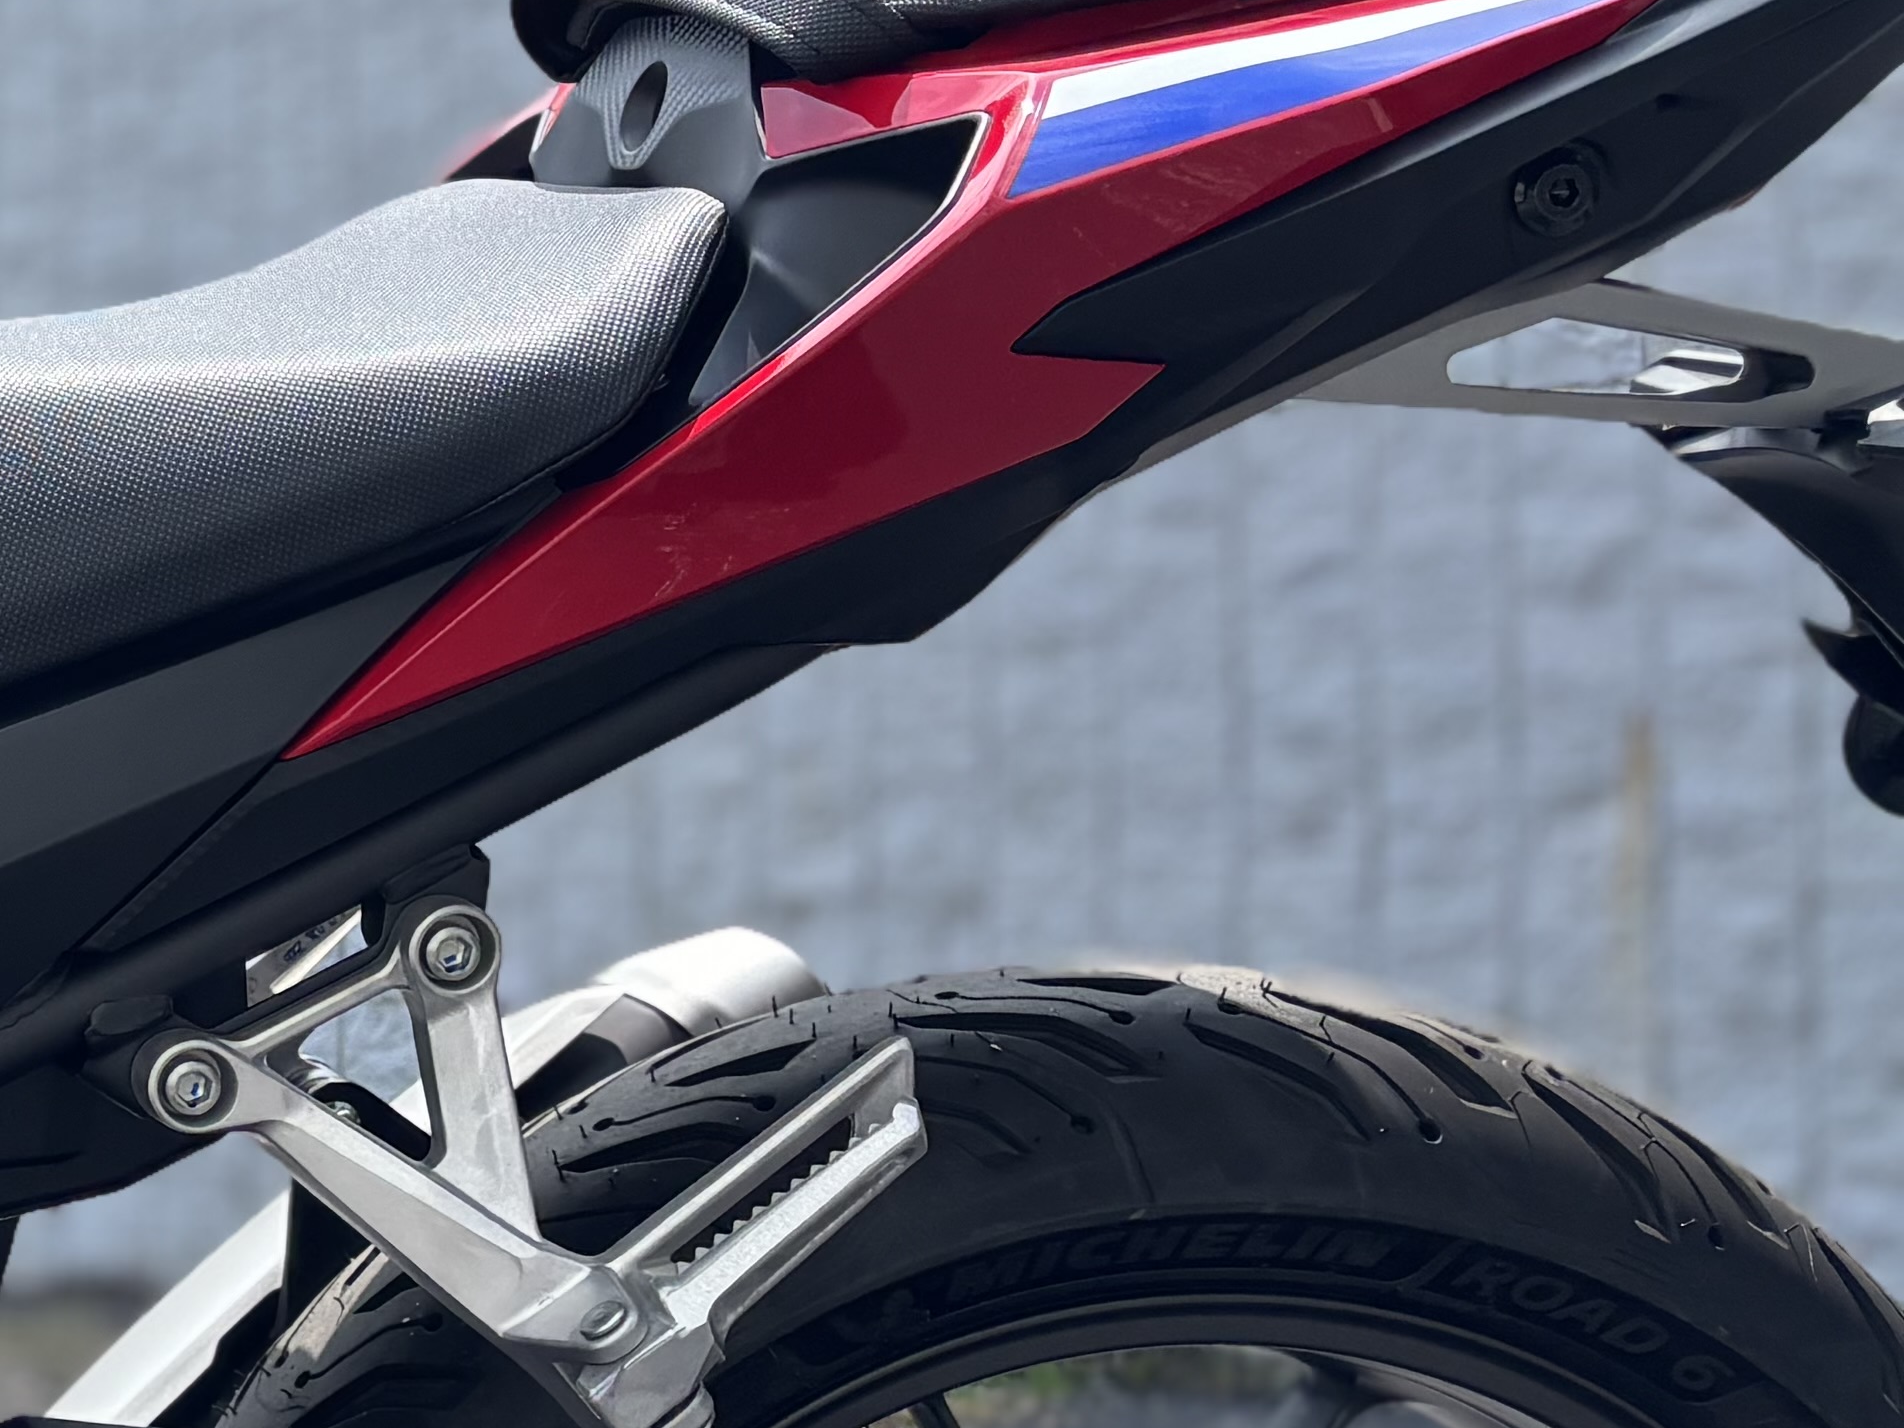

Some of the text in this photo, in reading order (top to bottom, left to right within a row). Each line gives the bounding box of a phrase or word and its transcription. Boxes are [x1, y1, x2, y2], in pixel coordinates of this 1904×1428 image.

[951, 1220, 1733, 1391] MICHELIN ROAD 6
